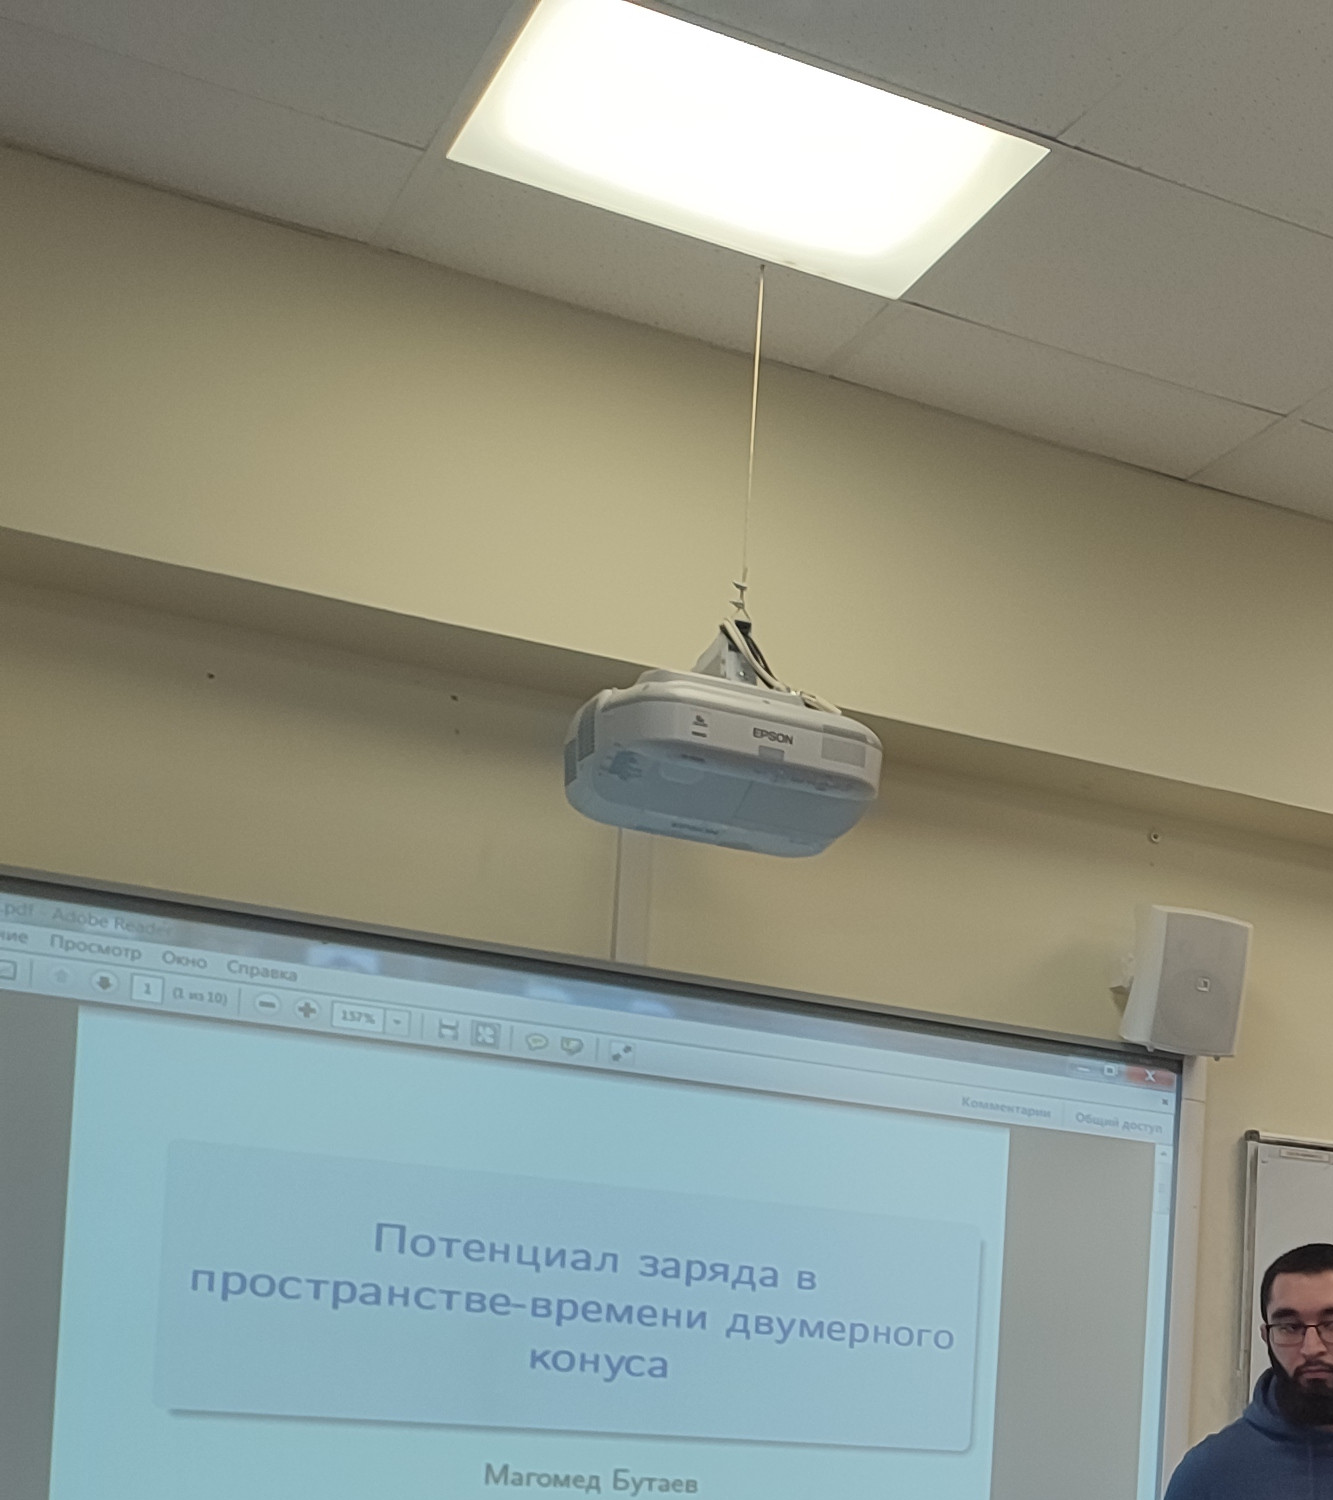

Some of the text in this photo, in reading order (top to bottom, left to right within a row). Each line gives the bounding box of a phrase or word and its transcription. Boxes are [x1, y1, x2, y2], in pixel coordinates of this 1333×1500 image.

[753, 727, 794, 745] EPSON
[52, 907, 109, 929] Adobe
[114, 917, 174, 936] Reader
[50, 934, 142, 961] Просмотр
[162, 950, 208, 970] Окно
[227, 959, 298, 983] Справка
[961, 1096, 1052, 1119] Комментарии
[1075, 1111, 1163, 1135] Общий доступ
[372, 1222, 817, 1293] Потенциал заряда в
[190, 1265, 955, 1352] пространстве-времени двумерного
[528, 1346, 670, 1381] конуса
[484, 1463, 699, 1497] Магомед Бутаев
